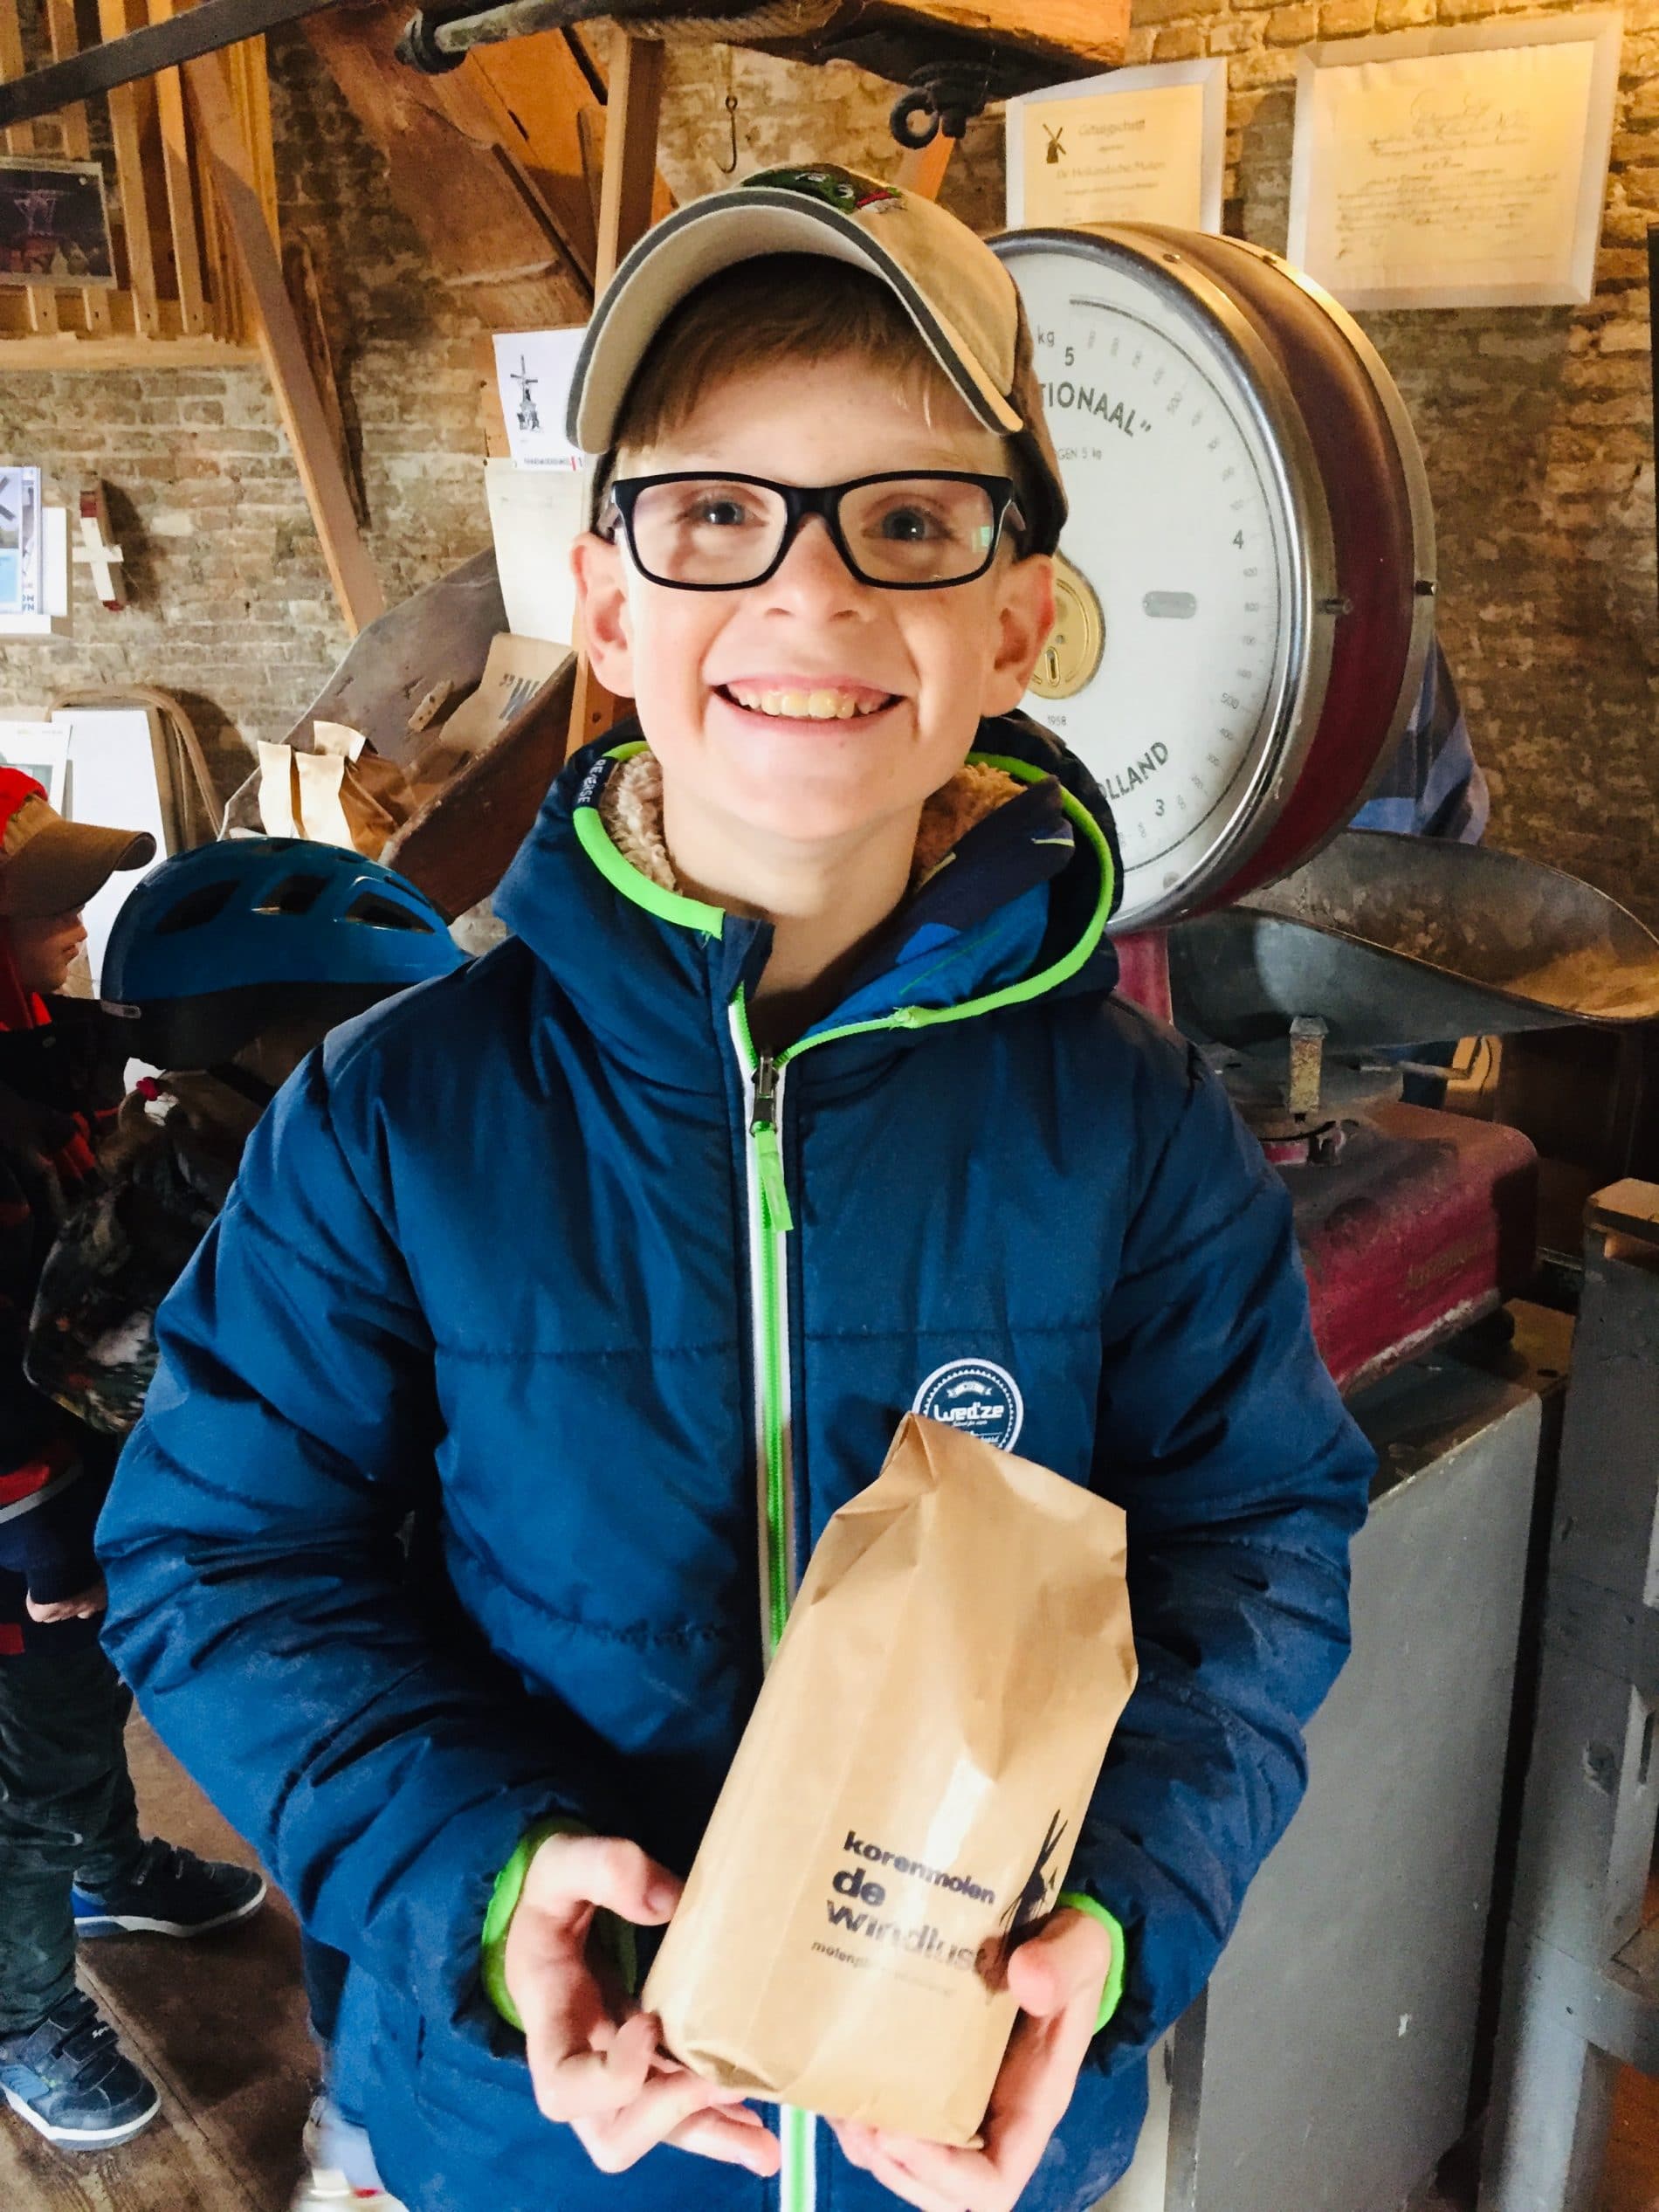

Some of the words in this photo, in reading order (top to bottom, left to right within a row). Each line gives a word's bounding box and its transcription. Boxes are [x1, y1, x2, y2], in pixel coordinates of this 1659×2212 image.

[1037, 326, 1055, 347] kg
[1064, 347, 1075, 366] 5
[1232, 529, 1244, 549] 4
[1154, 798, 1166, 817] 3
[843, 1830, 996, 1905] korenmolen
[831, 1867, 886, 1907] de
[827, 1900, 979, 1972] windlus
